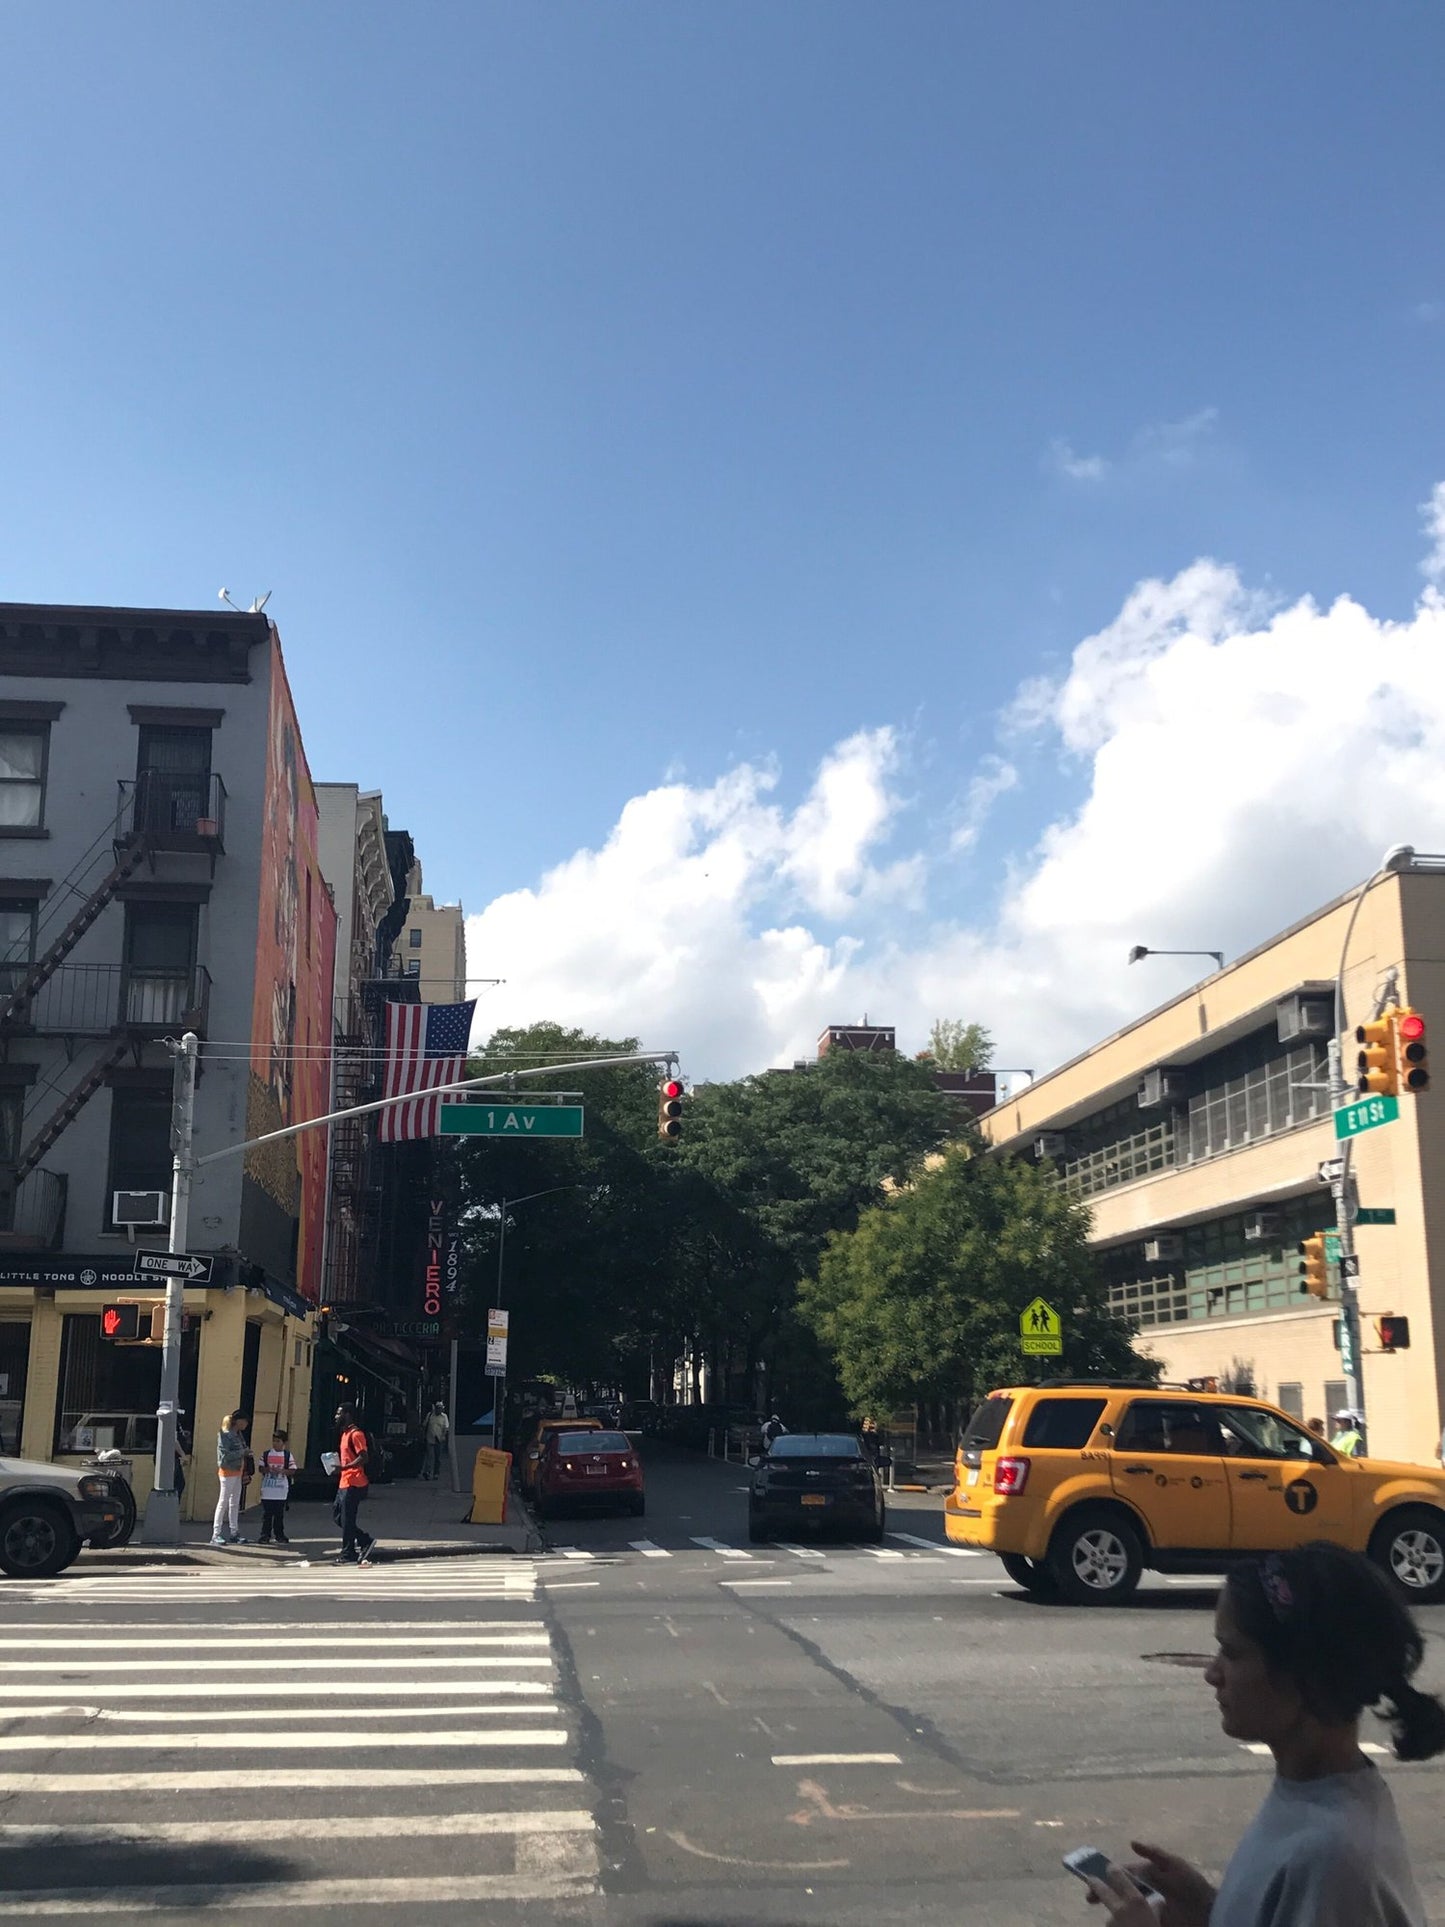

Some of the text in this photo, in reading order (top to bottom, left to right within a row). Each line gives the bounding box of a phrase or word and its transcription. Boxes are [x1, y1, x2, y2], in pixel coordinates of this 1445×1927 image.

[487, 1111, 536, 1129] 1 Av
[1347, 1100, 1385, 1130] E 11 St
[146, 1258, 201, 1273] ONE WAY
[424, 1200, 443, 1315] VENIERO
[446, 1240, 458, 1292] 1894
[0, 1272, 40, 1280] LITTLE
[43, 1273, 75, 1281] TONG
[101, 1273, 147, 1281] NOODLE
[1024, 1341, 1059, 1351] SCHOOL
[1290, 1486, 1312, 1510] T
